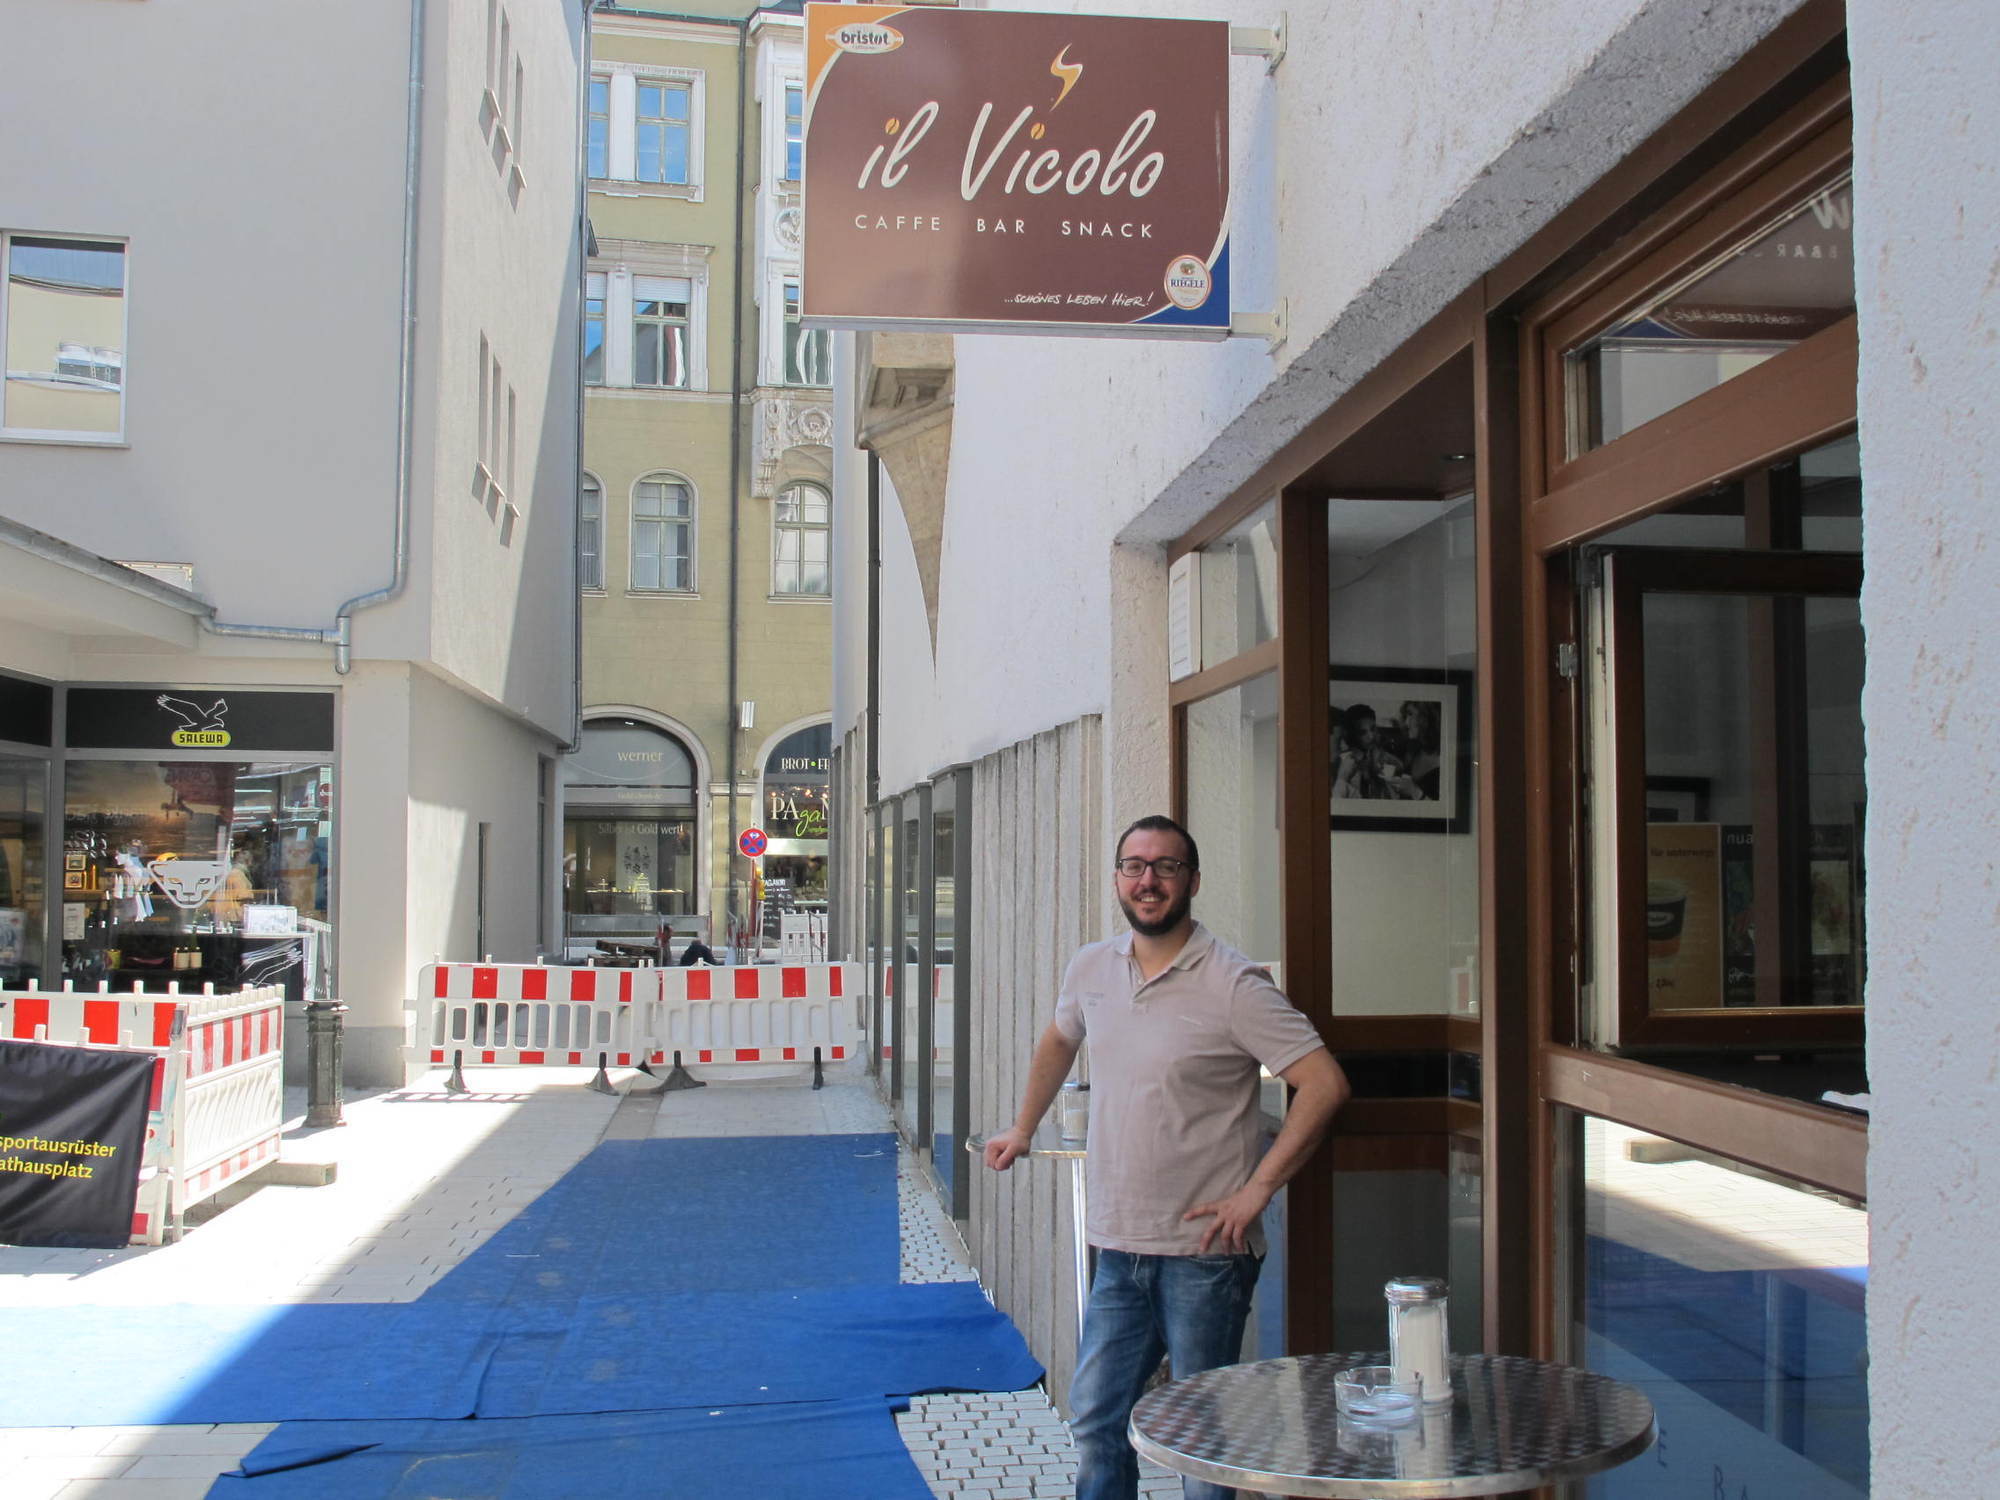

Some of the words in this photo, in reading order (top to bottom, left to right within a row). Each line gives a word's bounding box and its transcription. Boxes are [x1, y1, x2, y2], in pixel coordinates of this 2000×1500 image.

[841, 31, 889, 45] bristot
[858, 101, 939, 189] il
[961, 102, 1164, 201] Vicolo
[855, 214, 941, 231] CAFFE
[976, 218, 1025, 234] BAR
[1061, 220, 1152, 238] SNACK
[1170, 279, 1205, 288] RIEGELE
[1066, 293, 1107, 306] LEBEN
[179, 733, 223, 744] SALEWA
[617, 751, 664, 762] werner
[781, 758, 809, 770] BROT
